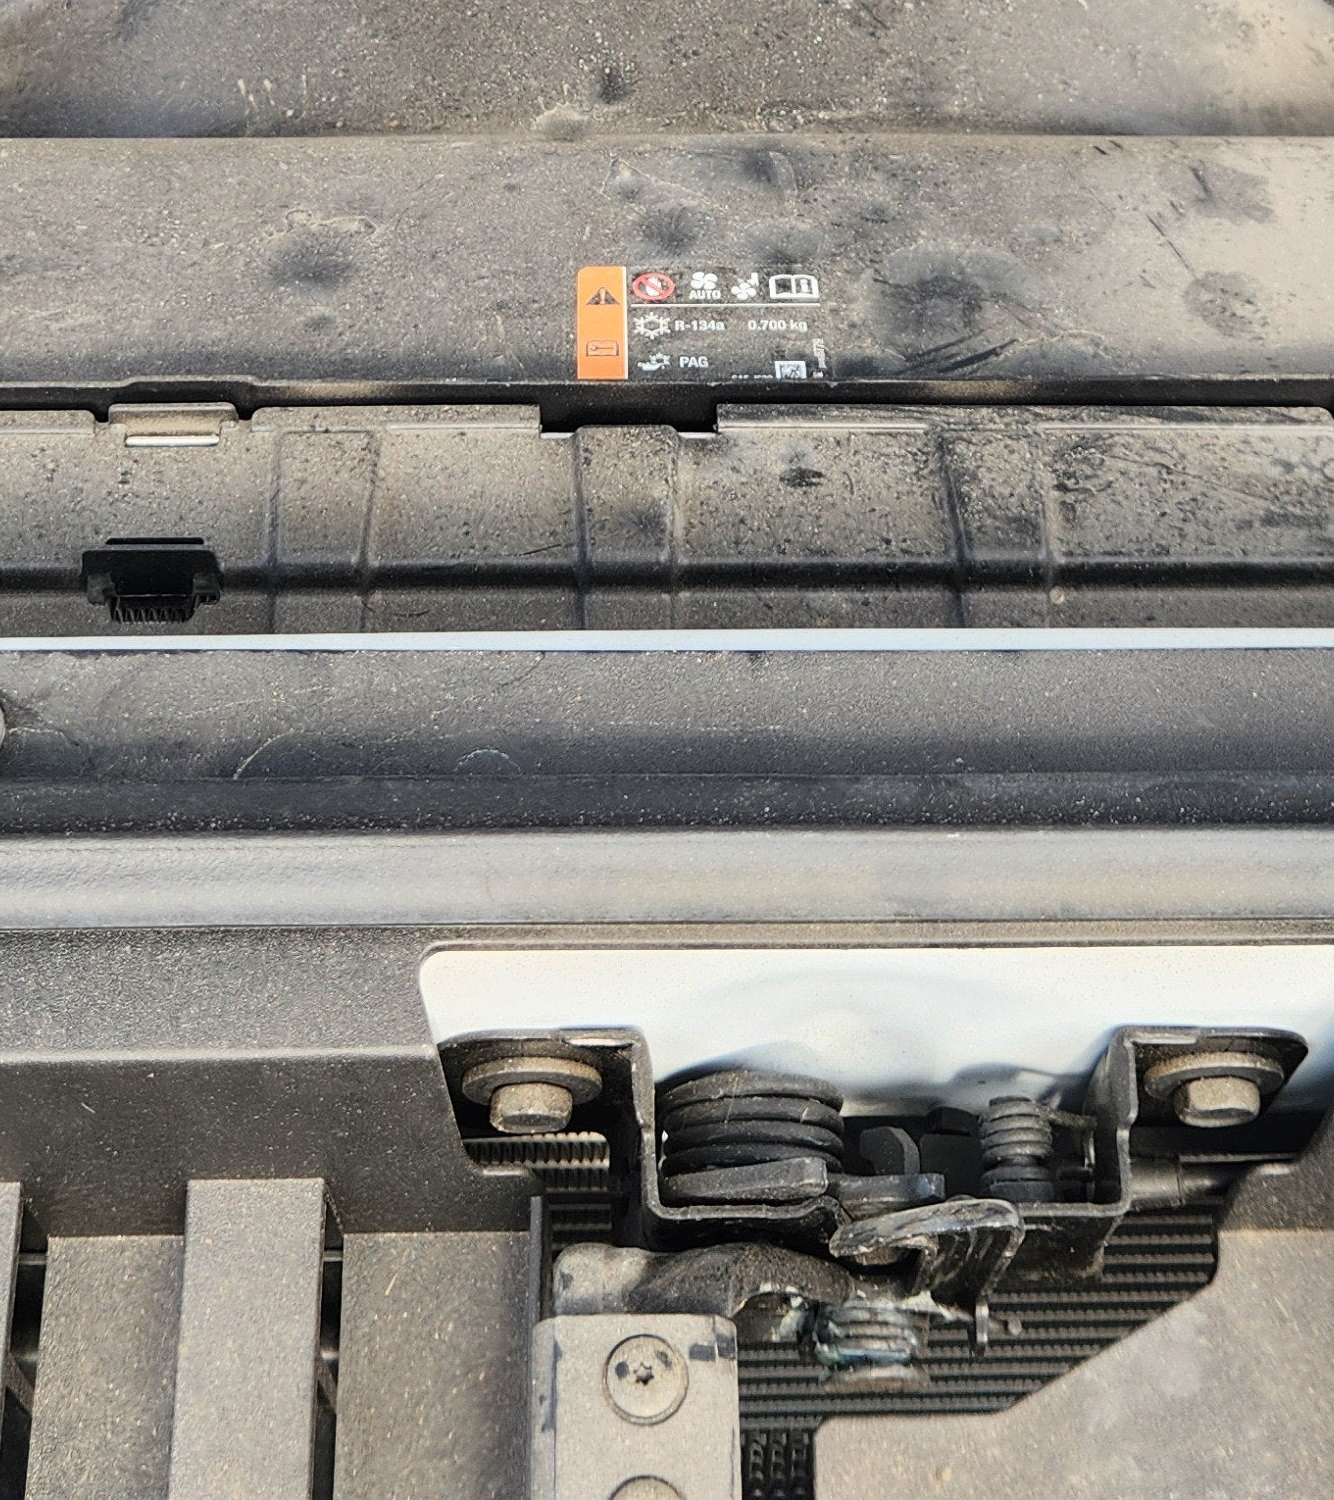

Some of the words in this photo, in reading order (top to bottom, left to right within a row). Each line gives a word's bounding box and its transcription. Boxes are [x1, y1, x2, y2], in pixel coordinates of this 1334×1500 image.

[689, 289, 722, 300] AUTO
[674, 320, 725, 331] R-134a
[747, 320, 786, 331] 0.700
[790, 320, 808, 333] kg
[679, 356, 709, 368] PAG
